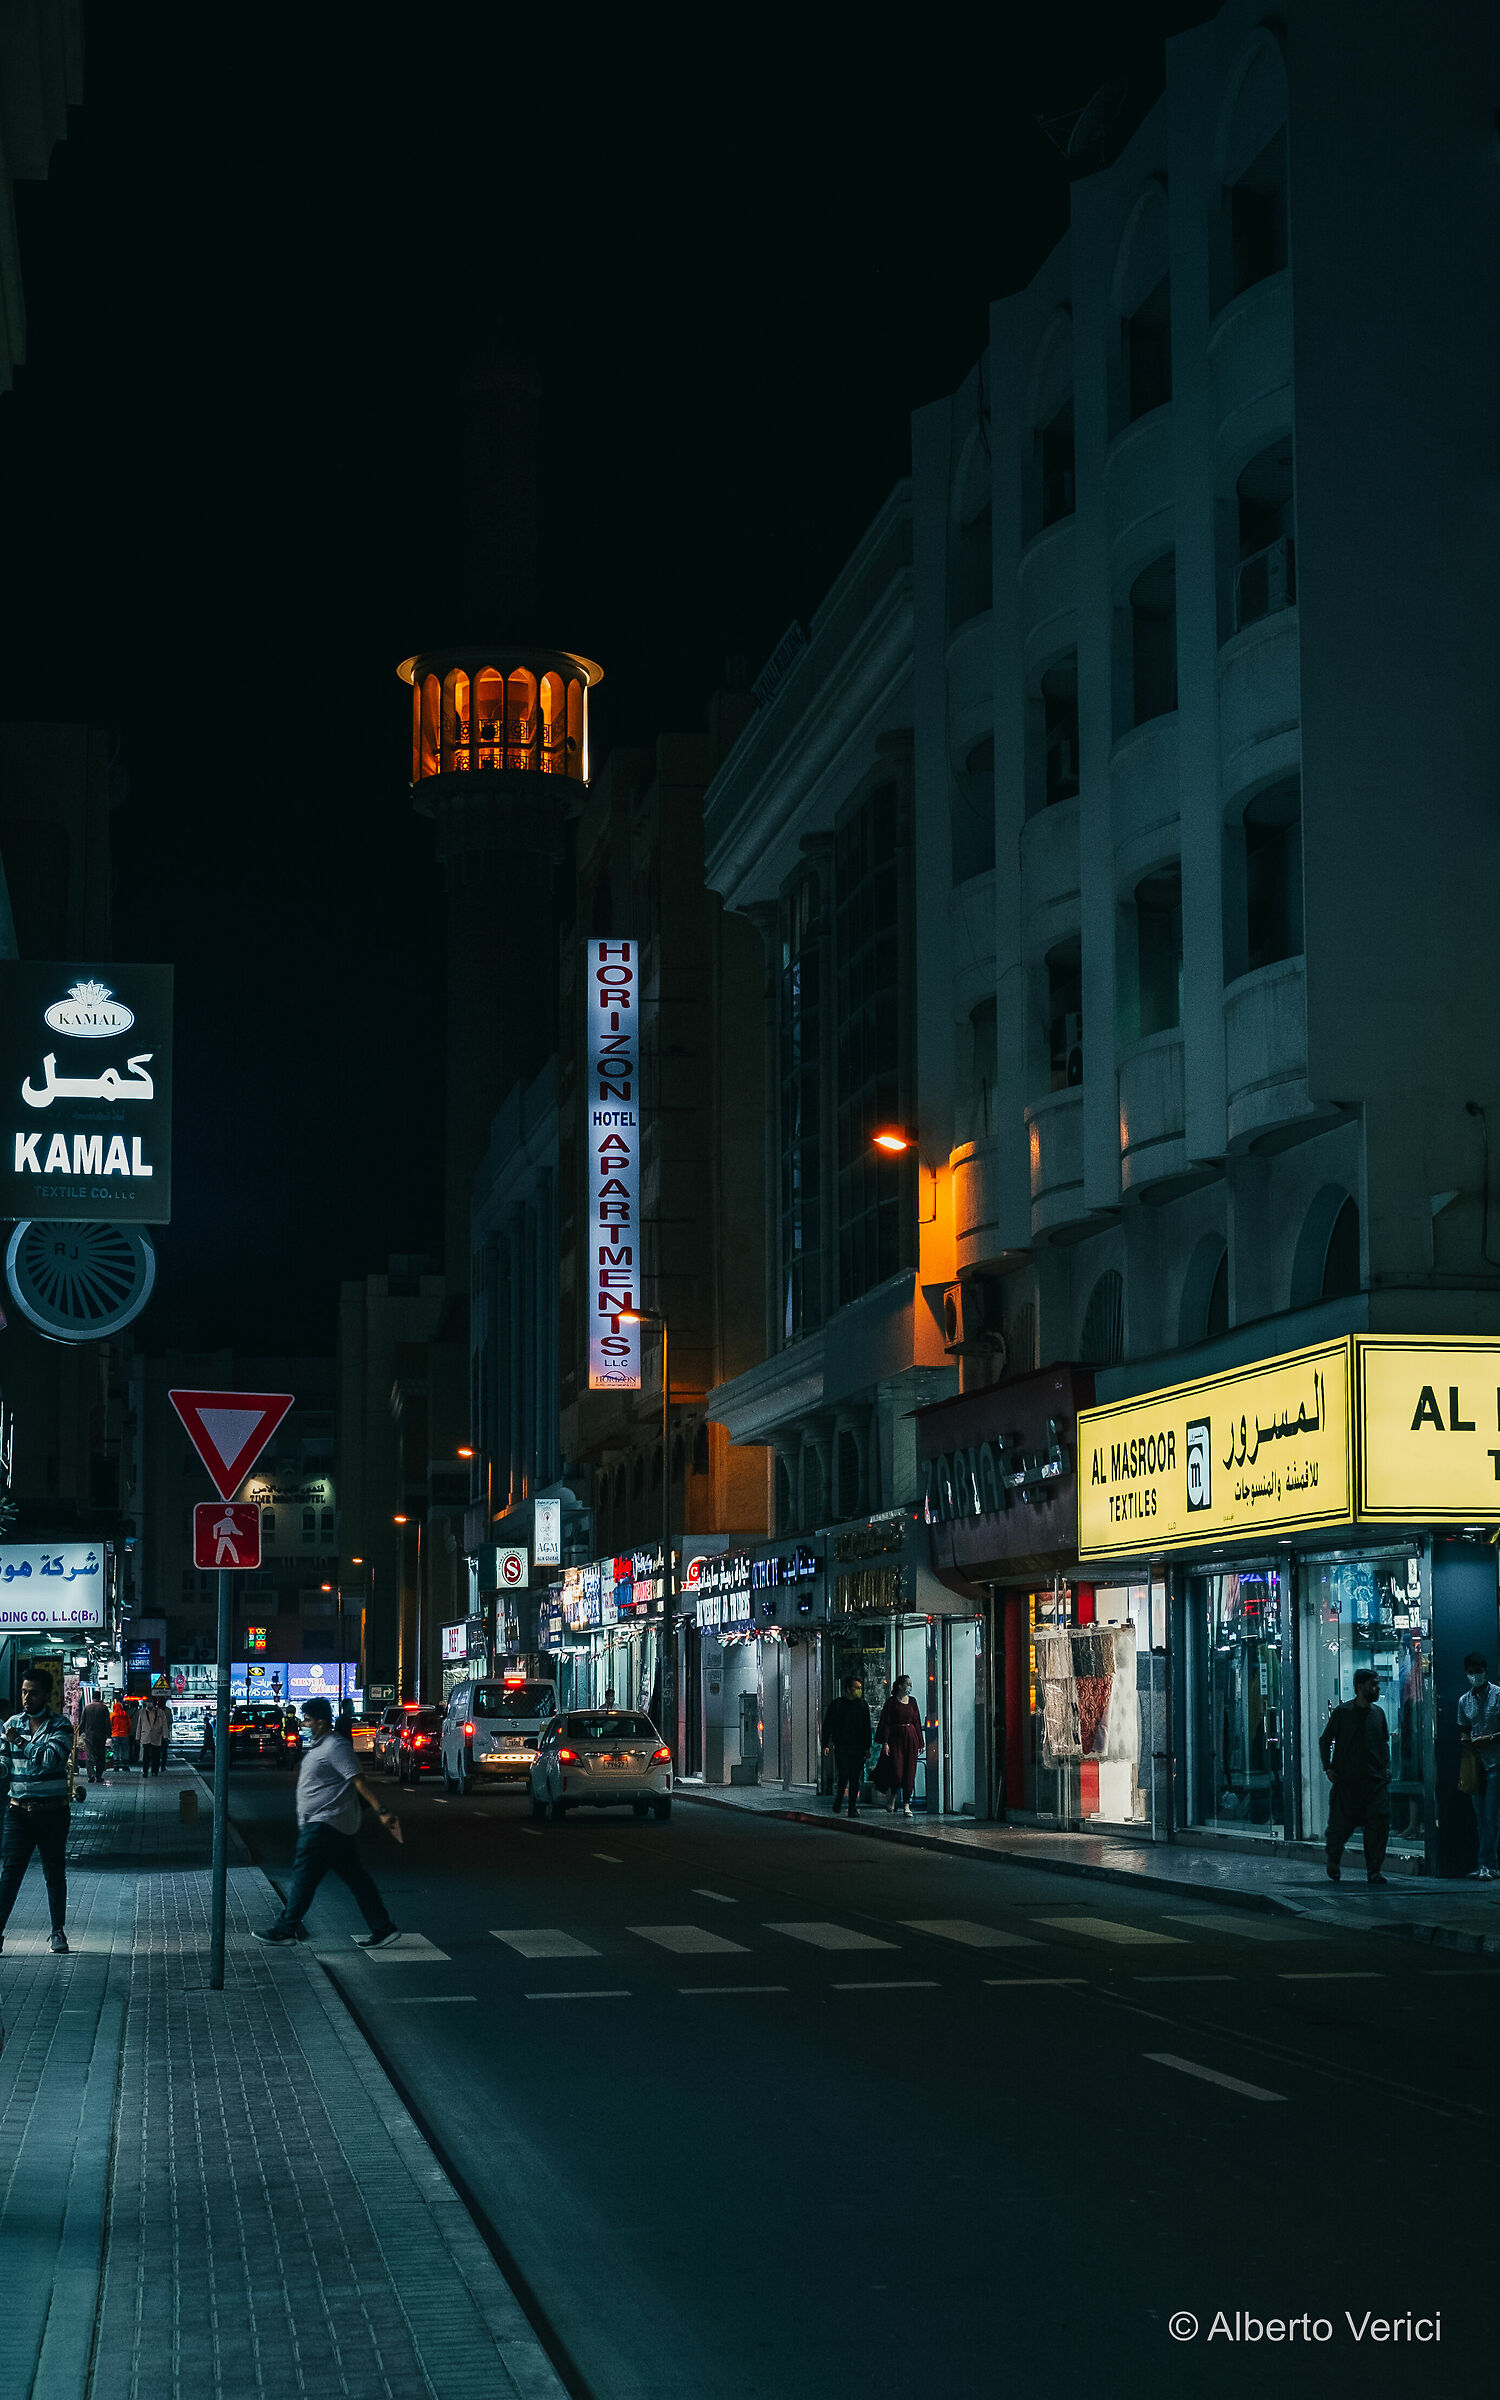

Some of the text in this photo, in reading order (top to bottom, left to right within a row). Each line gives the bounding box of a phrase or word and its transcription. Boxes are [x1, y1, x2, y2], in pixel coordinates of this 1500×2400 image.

[58, 1012, 121, 1026] KAMAL
[596, 942, 634, 1102] HORIZON
[593, 1111, 637, 1127] HOTEL
[14, 1132, 153, 1176] KAMAL
[34, 1186, 87, 1198] TEXTILE
[597, 1133, 634, 1357] APARTMENTS
[1222, 1368, 1326, 1471] المسرور
[1410, 1385, 1476, 1432] AL
[1091, 1430, 1176, 1486] AL MASROOR
[1109, 1488, 1157, 1523] TEXTILES
[40, 1551, 99, 1582] شركة
[506, 1560, 519, 1579] S
[31, 1611, 49, 1622] CO.
